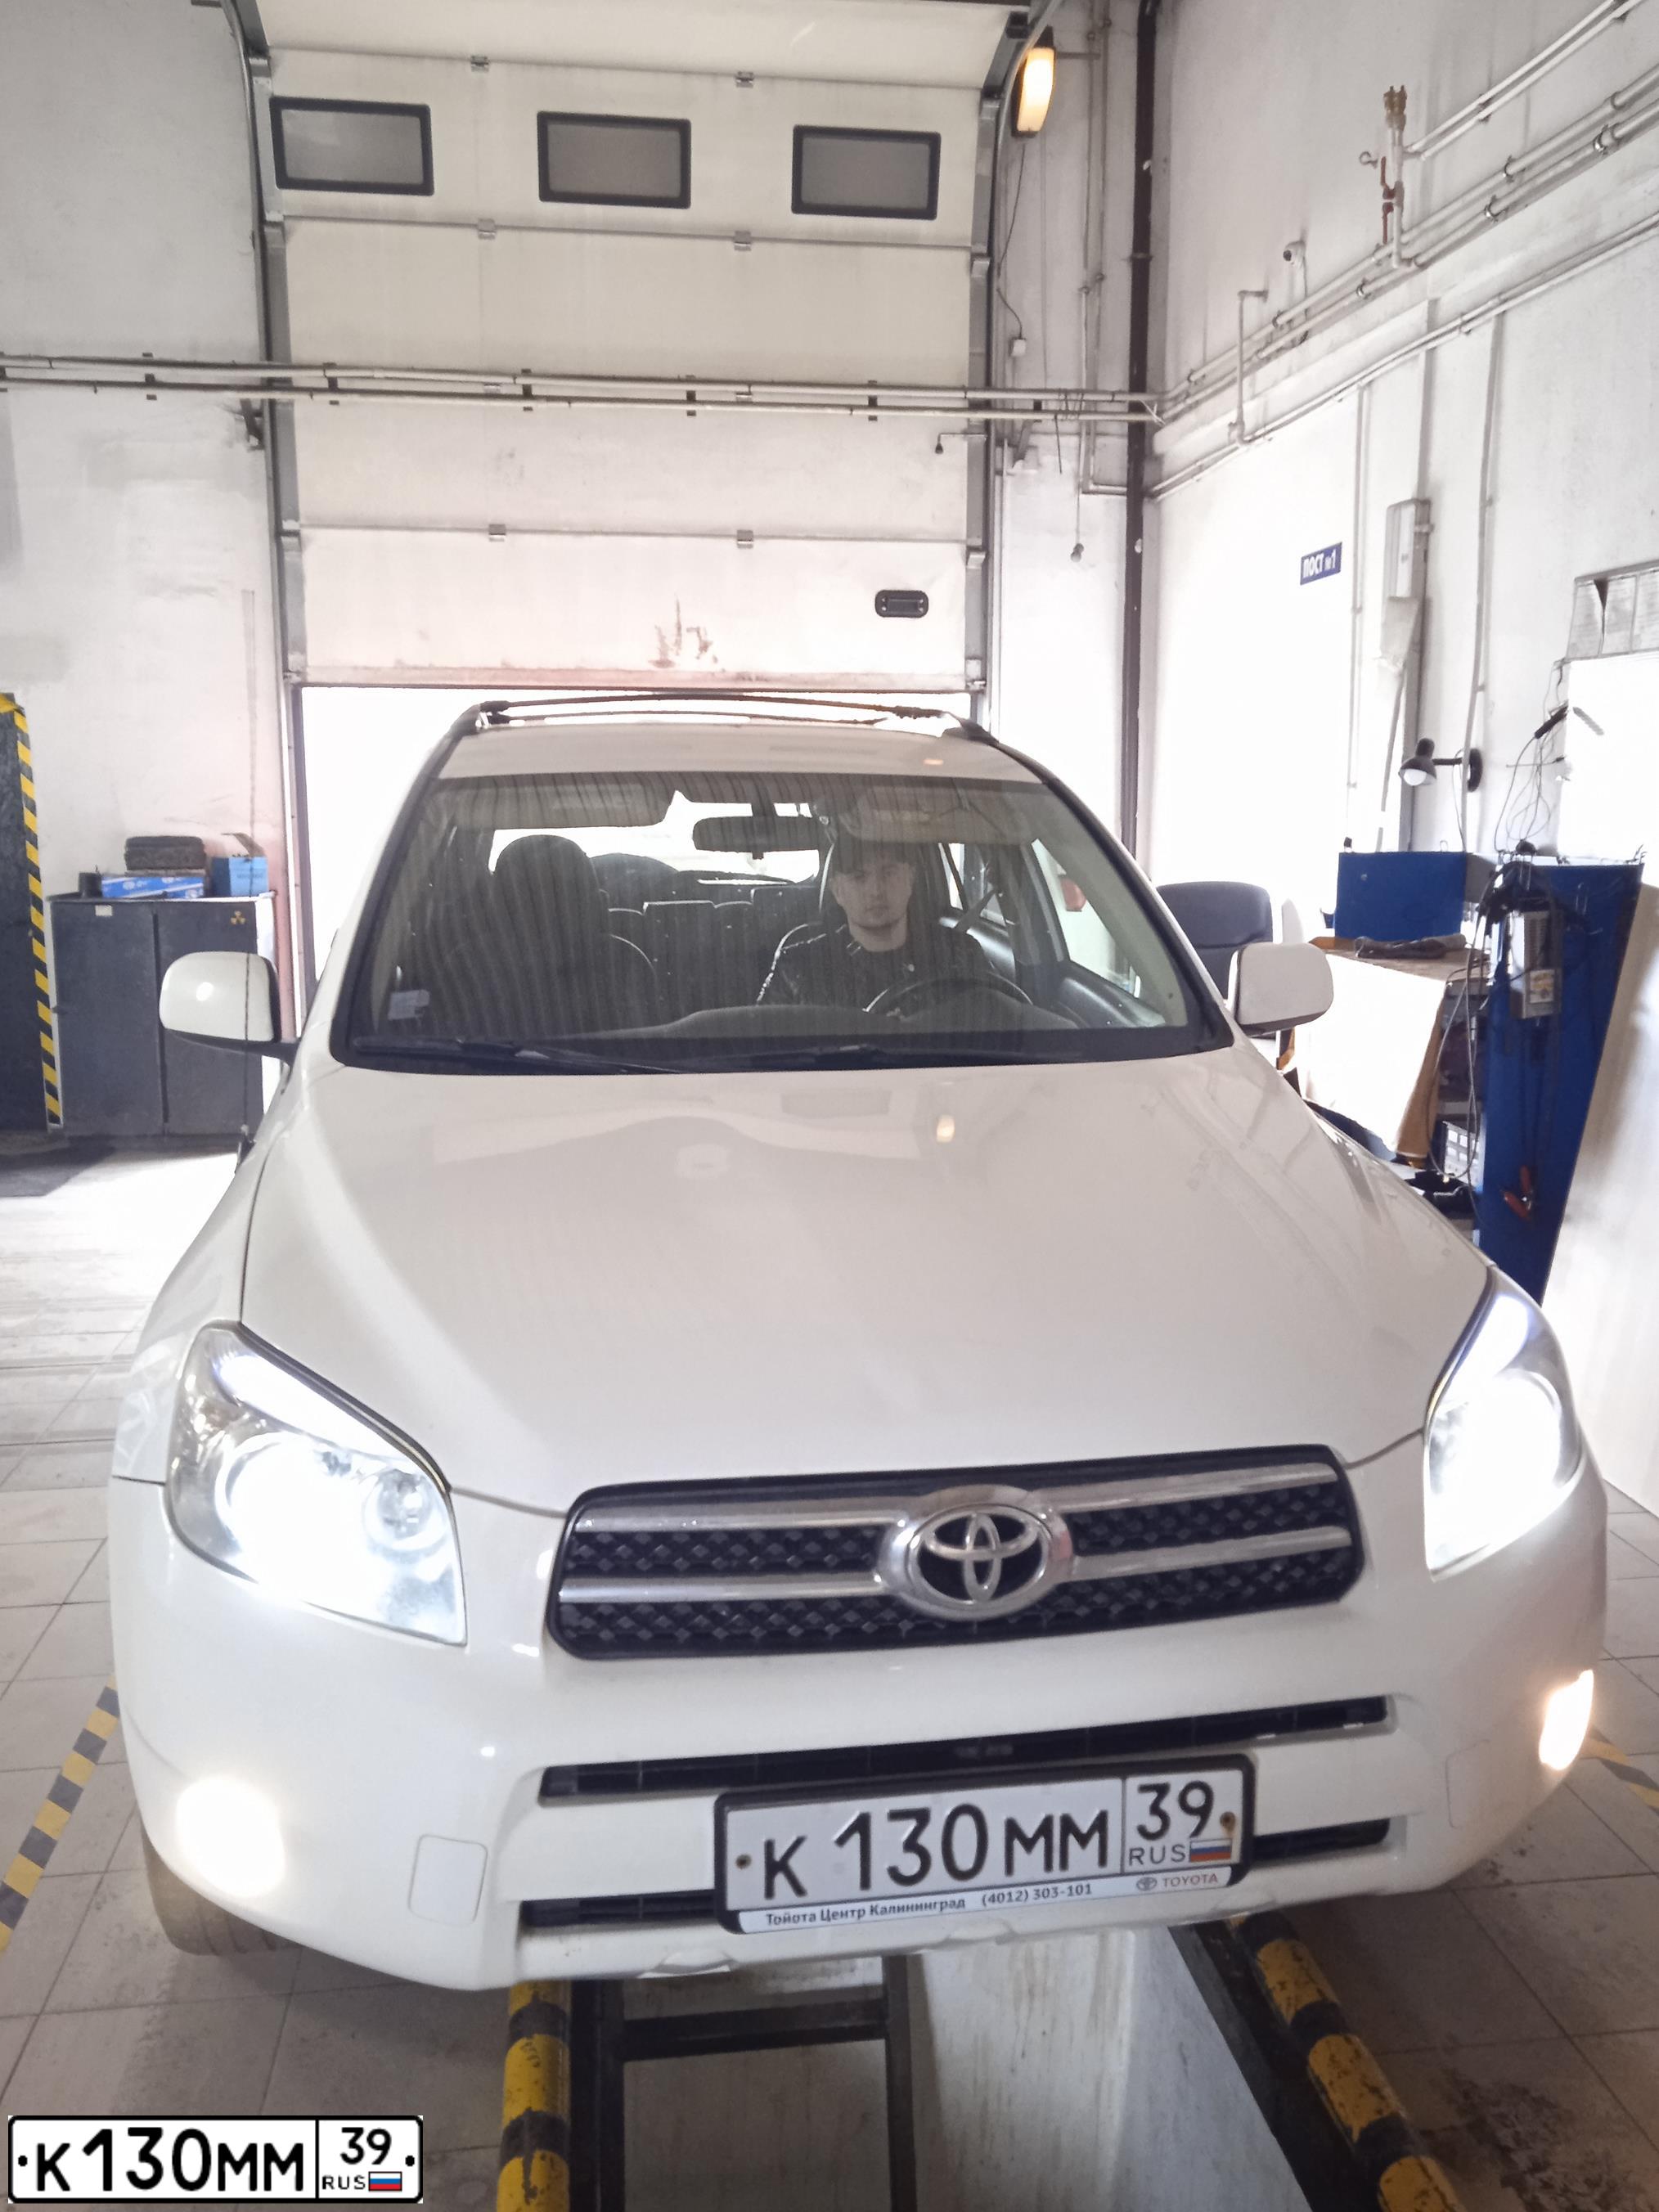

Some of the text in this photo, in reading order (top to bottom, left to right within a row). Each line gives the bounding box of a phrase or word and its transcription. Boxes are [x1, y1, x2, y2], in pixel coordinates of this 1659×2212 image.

[1136, 1781, 1215, 1841] 39
[1128, 1844, 1186, 1867] RUS
[1162, 1873, 1219, 1888] TOYOTA
[982, 1883, 1093, 1907] (4012) 303-101
[766, 1898, 965, 1926] Тойота Центр Калининград
